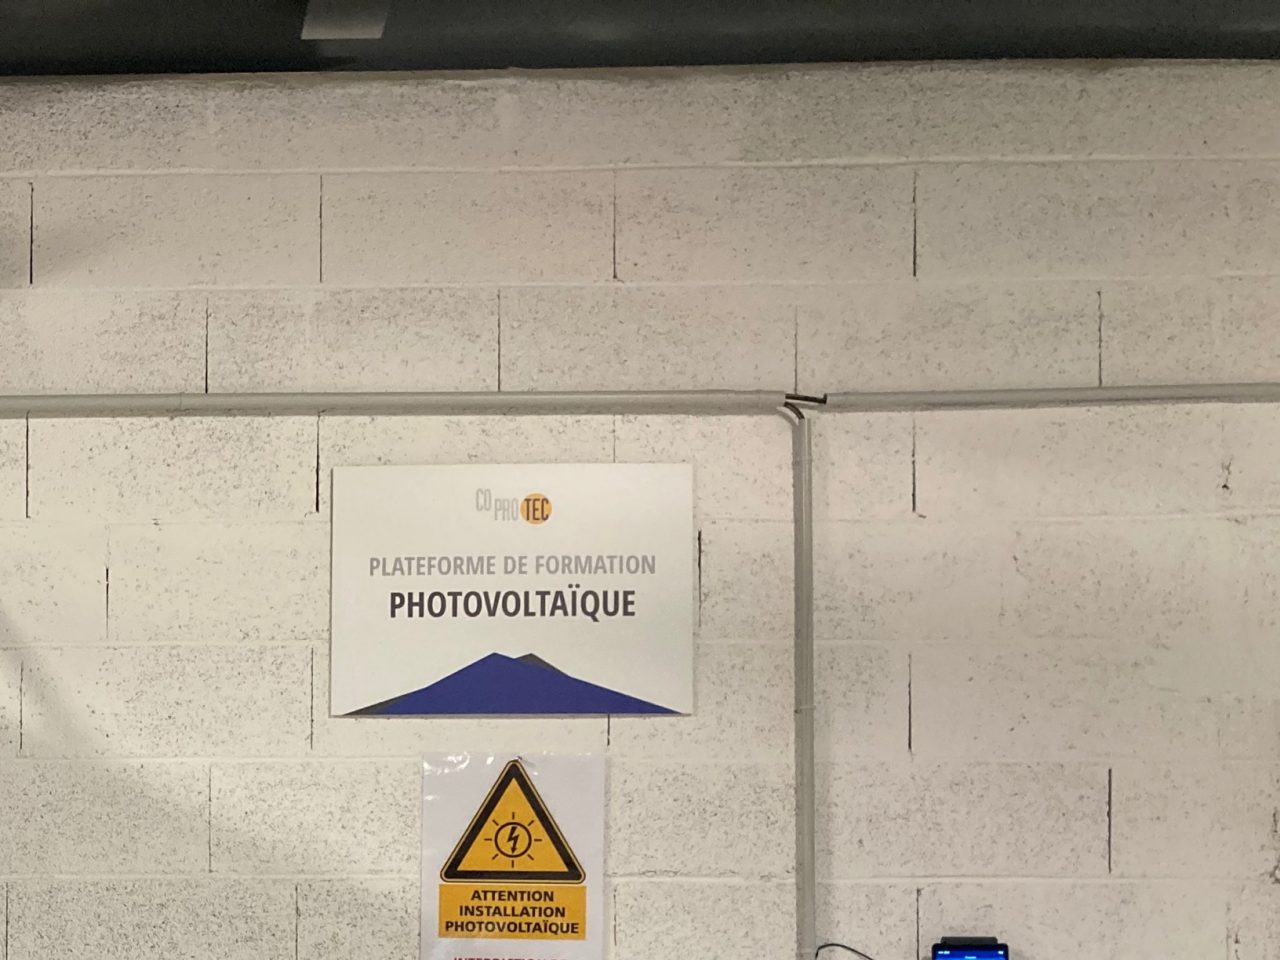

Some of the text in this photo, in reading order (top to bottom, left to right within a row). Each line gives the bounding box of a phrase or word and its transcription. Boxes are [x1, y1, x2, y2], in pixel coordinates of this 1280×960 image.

[369, 554, 656, 577] PLATEFORME DE FORMATION
[390, 583, 636, 623] PHOTOVOLTAÏQUE
[470, 890, 554, 902] ATTENTION
[459, 905, 566, 918] INSTALLATION
[444, 919, 580, 935] PHOTOVOLTAÏQUE
